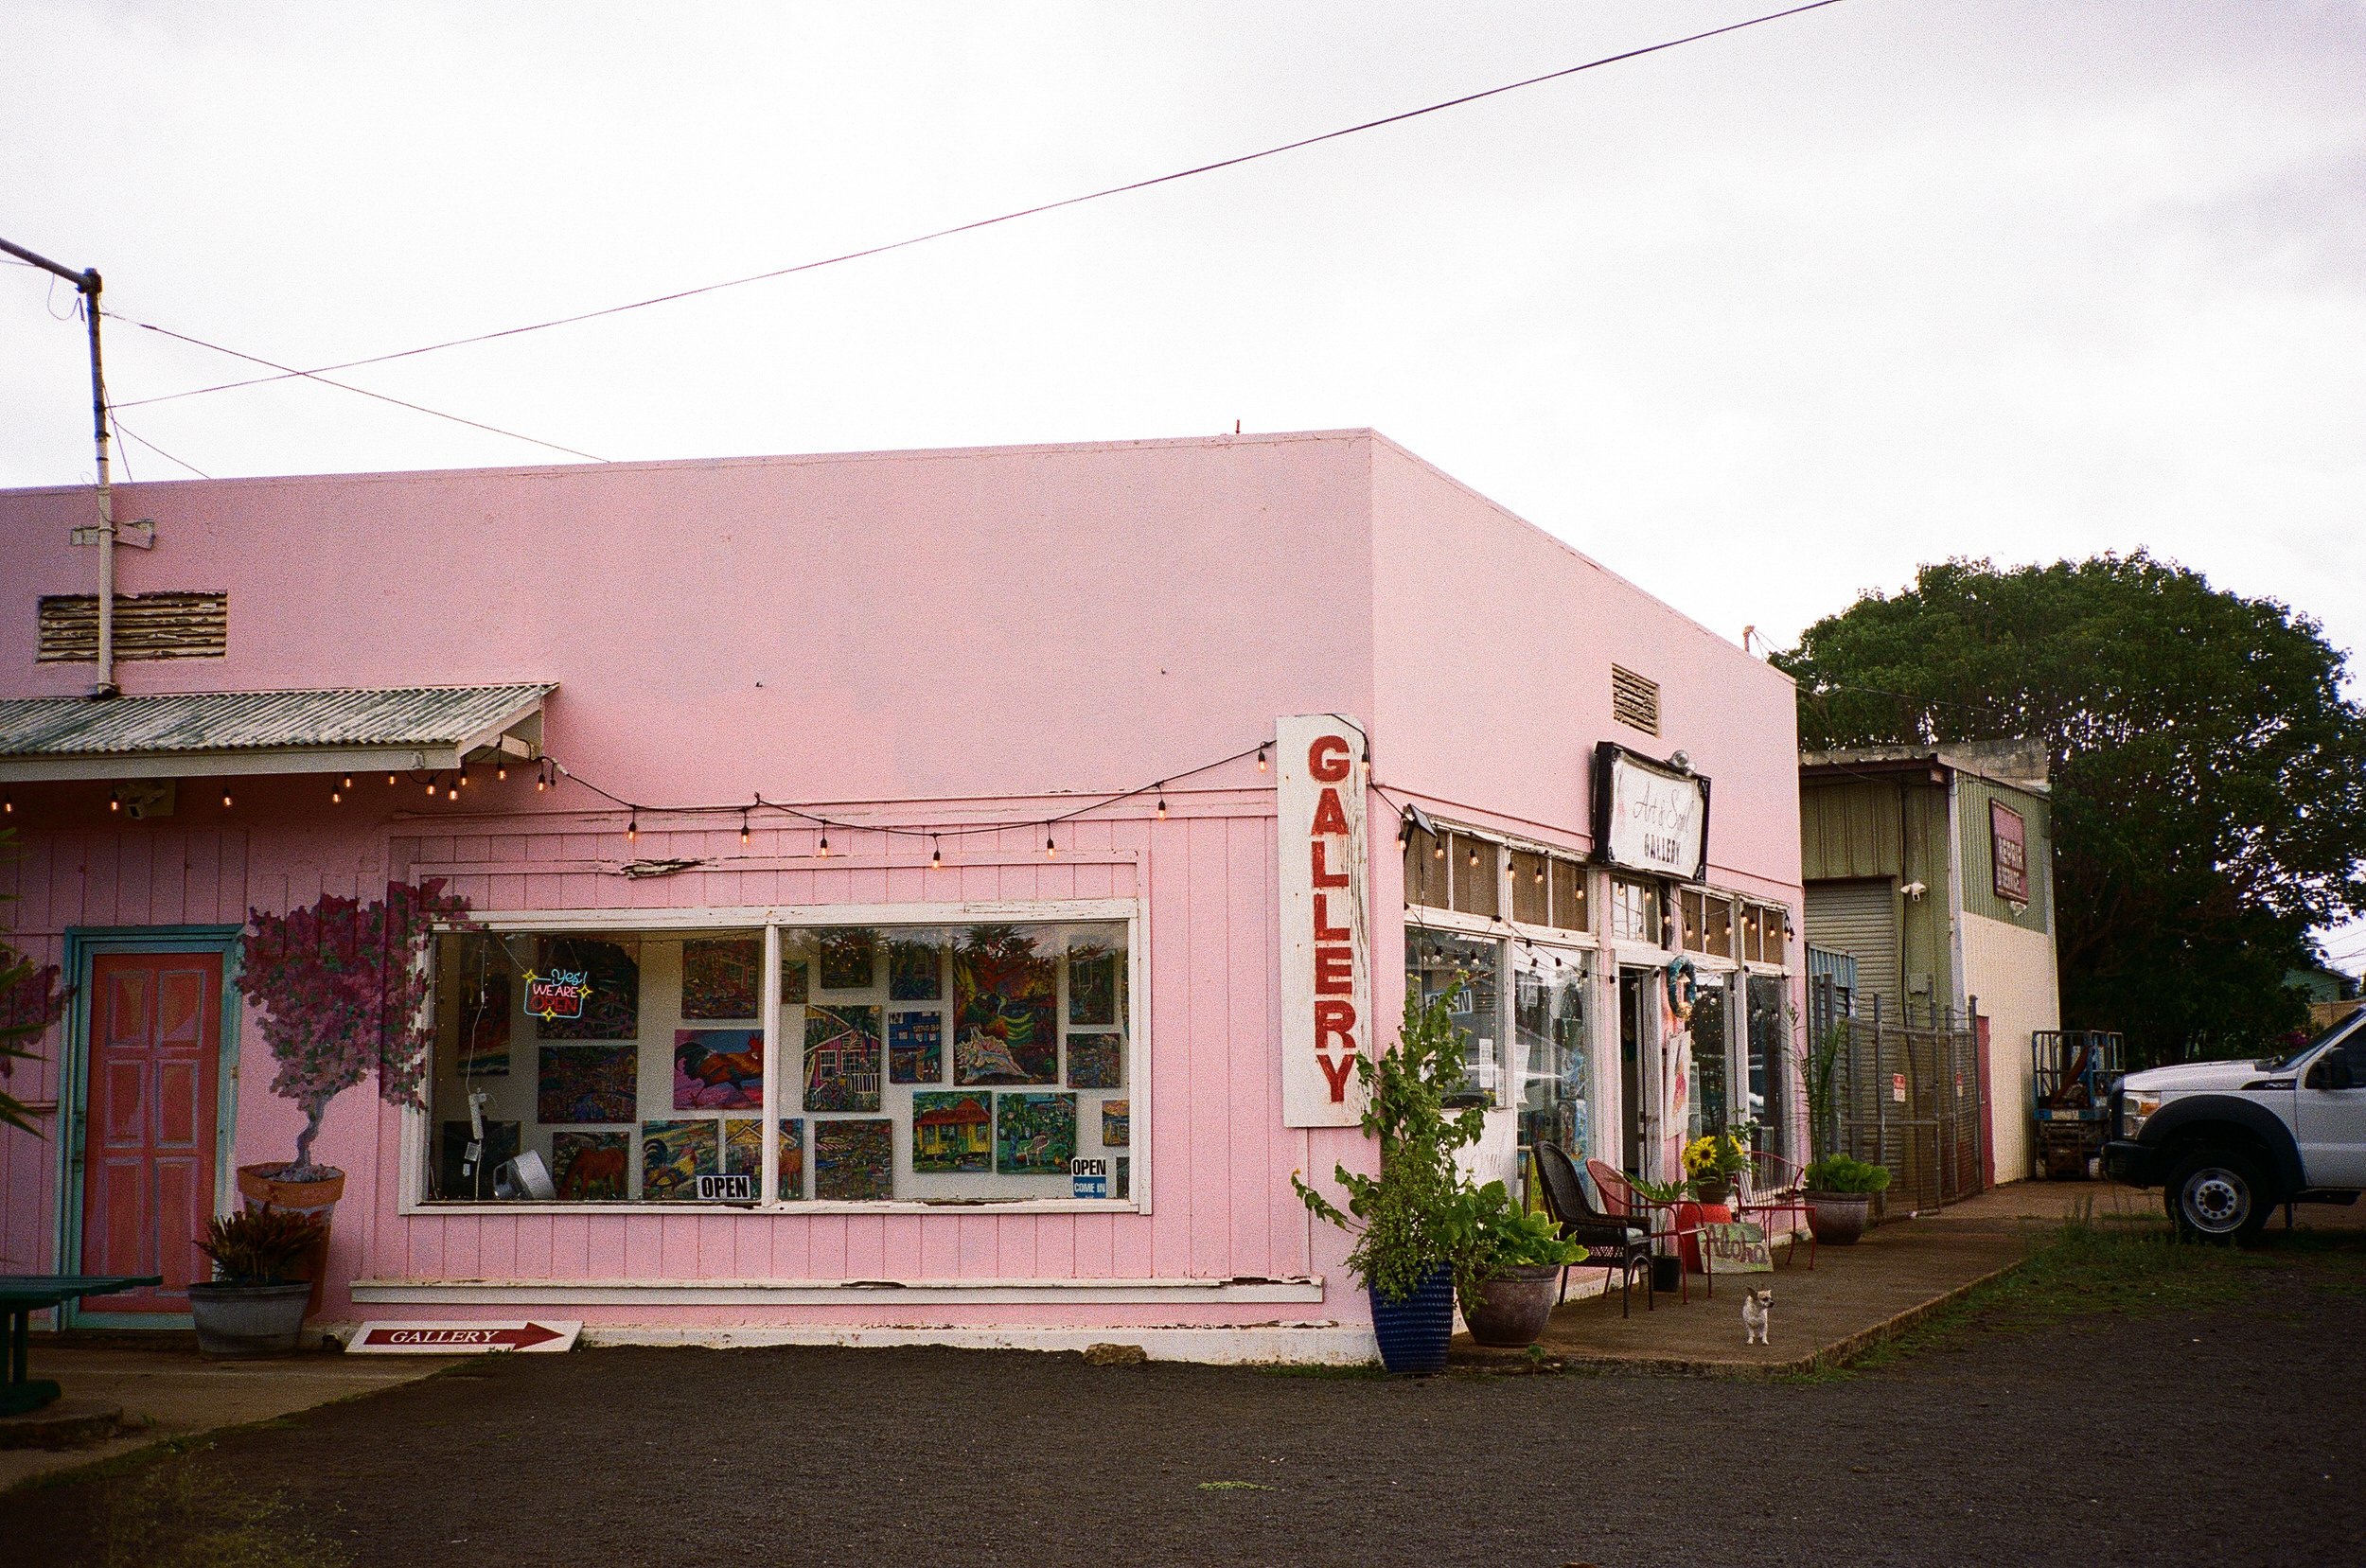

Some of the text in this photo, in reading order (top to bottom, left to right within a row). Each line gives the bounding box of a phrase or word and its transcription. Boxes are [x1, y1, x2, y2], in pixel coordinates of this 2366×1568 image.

[1633, 781, 1657, 823] Art
[1644, 833, 1681, 866] GALLERY
[1309, 734, 1357, 1103] GALLERY
[551, 968, 588, 986] Yes!
[533, 984, 578, 998] WE ARE
[531, 995, 577, 1012] OPEN
[1072, 1159, 1106, 1175] OPEN
[701, 1176, 749, 1198] OPEN
[1074, 1183, 1105, 1192] COME IN
[390, 1330, 500, 1343] GALLERY
